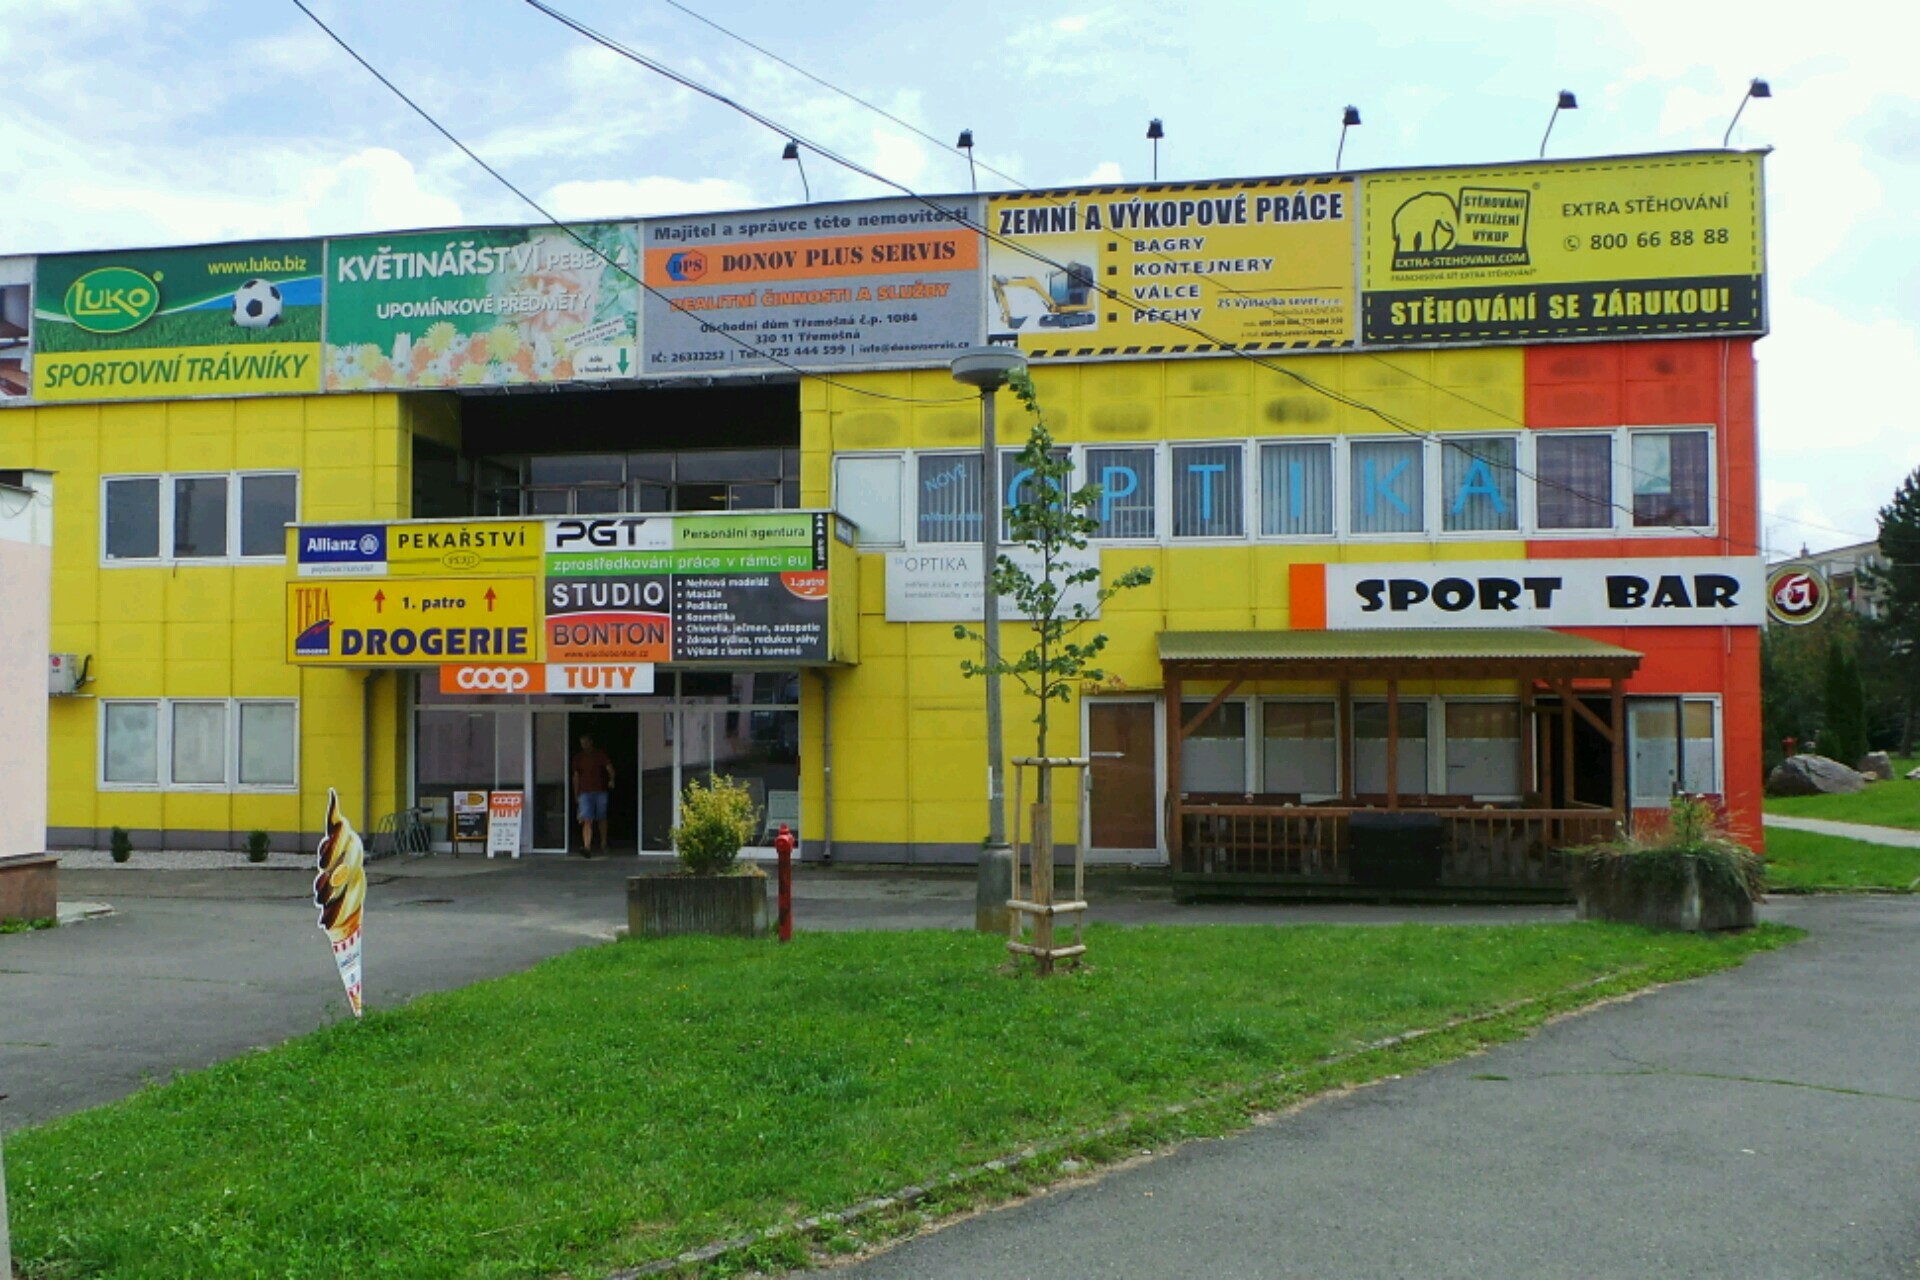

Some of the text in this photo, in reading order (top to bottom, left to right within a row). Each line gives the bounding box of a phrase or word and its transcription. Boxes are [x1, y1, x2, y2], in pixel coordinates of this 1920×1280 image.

[1000, 190, 1343, 235] ZEMNÍ A VÝKOPOVÉ PRÁCE
[1562, 191, 1730, 217] EXTRA STĚHOVÁNÍ
[654, 207, 968, 242] Majitel a správce této nemovitosti
[1472, 229, 1509, 242] VÝKUP
[1133, 236, 1206, 253] BAGRY
[1591, 228, 1729, 250] 800 66 88 88
[207, 255, 307, 275] www.luko.biz
[338, 238, 547, 283] KVĚTINÁŘSTVÍ
[722, 241, 957, 272] DONOV PLUS SERVIS
[1133, 258, 1275, 277] KONTEJNERY
[376, 289, 592, 319] UPOMÍNKOVÉ PŘEDMĚTY
[670, 280, 951, 312] REALITNÍ ČINNOSTI A SLUŽBY
[1133, 284, 1200, 299] VÁLCE
[1391, 285, 1730, 326] STĚHOVÁNÍ SE ZÁRUKOU!
[44, 350, 309, 389] SPORTOVNÍ TRÁVNÍKY
[307, 537, 357, 553] Allianz
[397, 526, 525, 549] PEKAŘSTVÍ
[556, 519, 648, 549] PGT
[682, 527, 806, 541] Personální agentura
[554, 553, 807, 574] zprostředkování práce v rámci eu
[904, 556, 968, 573] OPTIKA
[402, 596, 467, 612] 1. patro
[551, 581, 665, 607] STUDIO
[1354, 574, 1740, 611] SPORT BAR
[341, 627, 528, 656] DROGERIE
[553, 622, 666, 647] BONTON
[457, 666, 637, 693] coop TUTY
